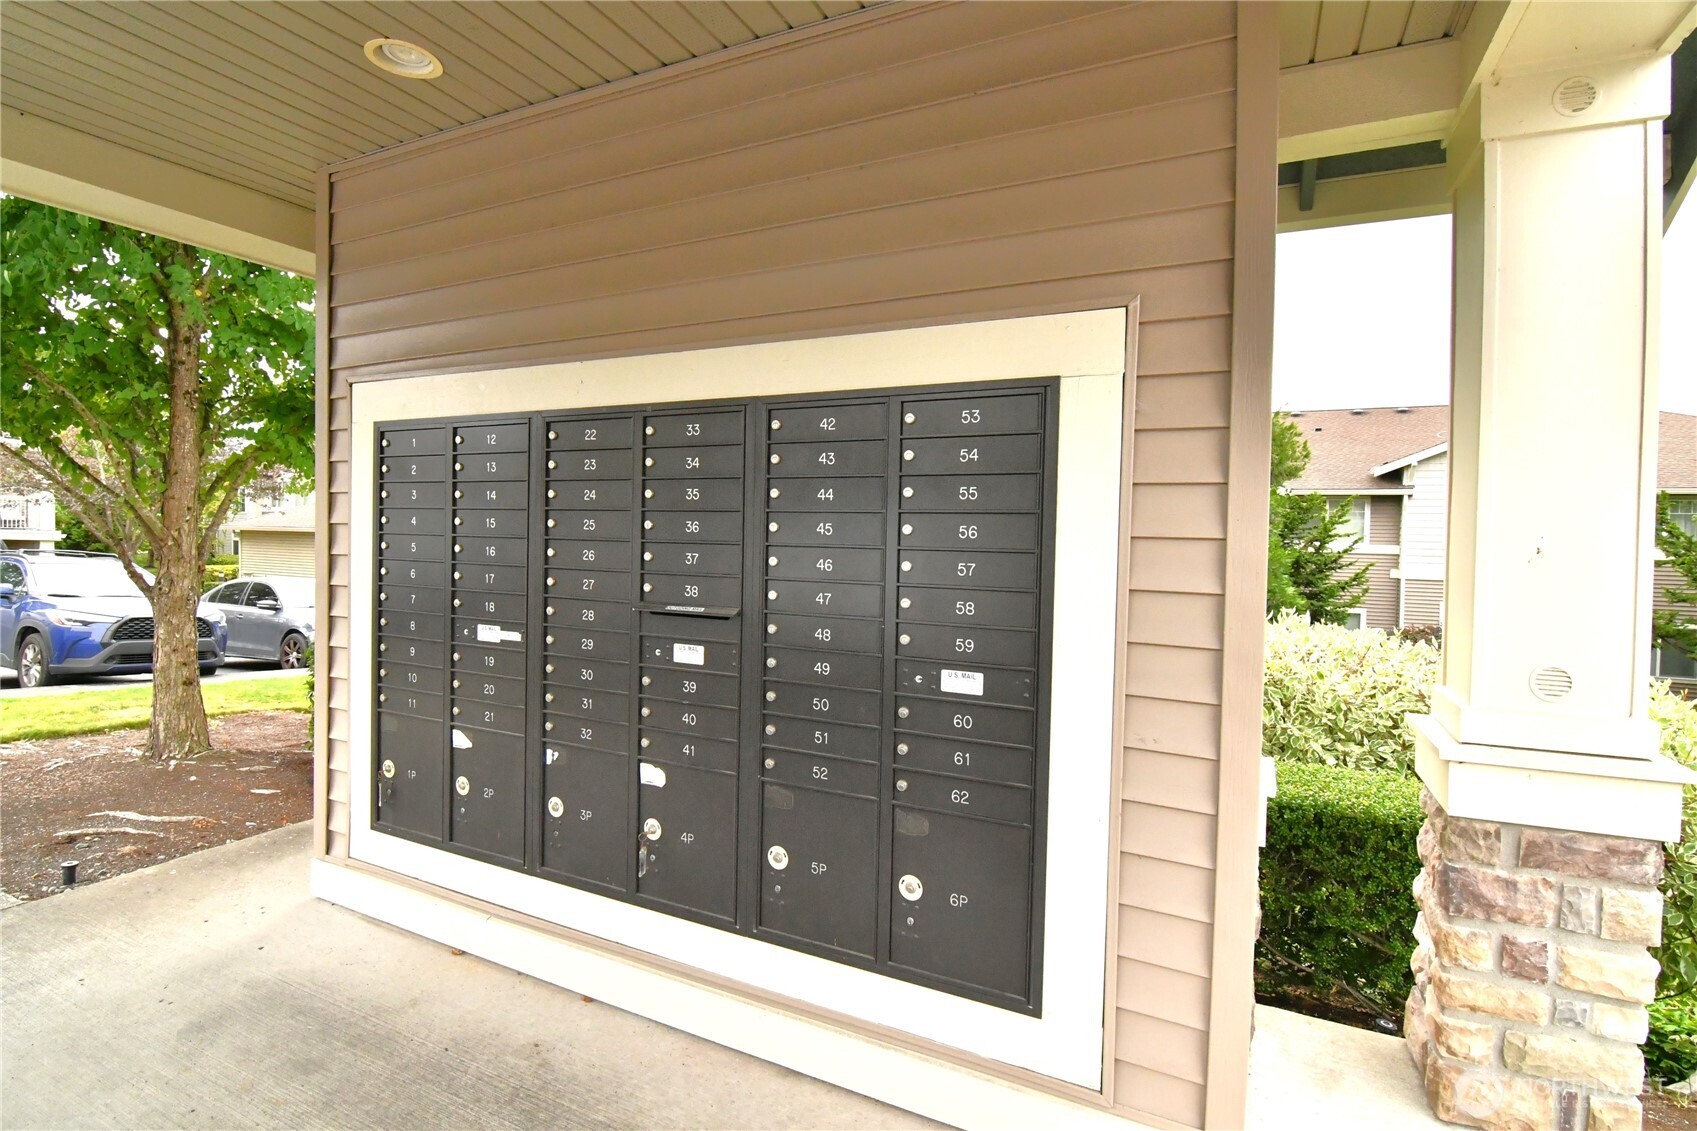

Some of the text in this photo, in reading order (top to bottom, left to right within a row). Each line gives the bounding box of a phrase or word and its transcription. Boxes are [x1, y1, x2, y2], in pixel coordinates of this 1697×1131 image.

[961, 409, 981, 424] 53
[685, 423, 701, 436] 33
[819, 417, 836, 431] 42
[486, 433, 497, 445] 12
[584, 428, 597, 441] 22
[818, 452, 836, 465] 43
[959, 448, 979, 463] 54
[486, 461, 497, 473] 13
[583, 458, 597, 471] 23
[685, 456, 700, 469] 34
[411, 464, 417, 475] 2
[411, 489, 417, 500] 3
[486, 490, 497, 501] 14
[583, 489, 597, 501] 24
[685, 488, 700, 501] 35
[817, 488, 834, 502] 44
[958, 486, 978, 501] 55
[410, 516, 417, 526] 4
[485, 517, 496, 529] 15
[583, 518, 596, 531] 25
[685, 520, 700, 533] 36
[816, 522, 833, 536] 45
[958, 525, 978, 539] 56
[411, 542, 417, 553] 5
[485, 546, 496, 557] 16
[582, 549, 595, 561] 26
[685, 552, 699, 565] 37
[816, 558, 833, 572] 46
[957, 562, 976, 577] 57
[410, 568, 416, 579] 6
[485, 573, 495, 584] 17
[582, 578, 595, 591] 27
[684, 584, 699, 598] 38
[410, 594, 416, 604] 7
[815, 592, 832, 606] 47
[485, 601, 495, 613] 18
[955, 601, 975, 616] 58
[581, 609, 595, 622] 28
[409, 620, 416, 631] 8
[814, 628, 832, 642] 48
[581, 638, 594, 650] 29
[955, 638, 975, 653] 59
[409, 646, 416, 657] 9
[484, 655, 495, 667] 19
[580, 668, 594, 681] 30
[813, 662, 831, 676] 49
[408, 672, 418, 683] 10
[961, 672, 977, 681] MAIL
[483, 683, 495, 695] 20
[682, 680, 697, 694] 39
[408, 698, 416, 709] 11
[581, 697, 593, 710] 31
[812, 697, 830, 712] 50
[484, 711, 494, 722] 21
[681, 712, 697, 726] 40
[953, 714, 973, 729] 60
[580, 727, 593, 741] 32
[814, 730, 828, 745] 51
[682, 744, 695, 757] 41
[953, 751, 970, 766] 61
[407, 769, 417, 779] 1P
[812, 765, 829, 781] 52
[483, 787, 495, 799] 2P
[951, 789, 970, 805] 62
[579, 809, 593, 821] 3P
[680, 832, 695, 845] 4P
[810, 861, 827, 875] 5P
[949, 893, 969, 908] 6P
